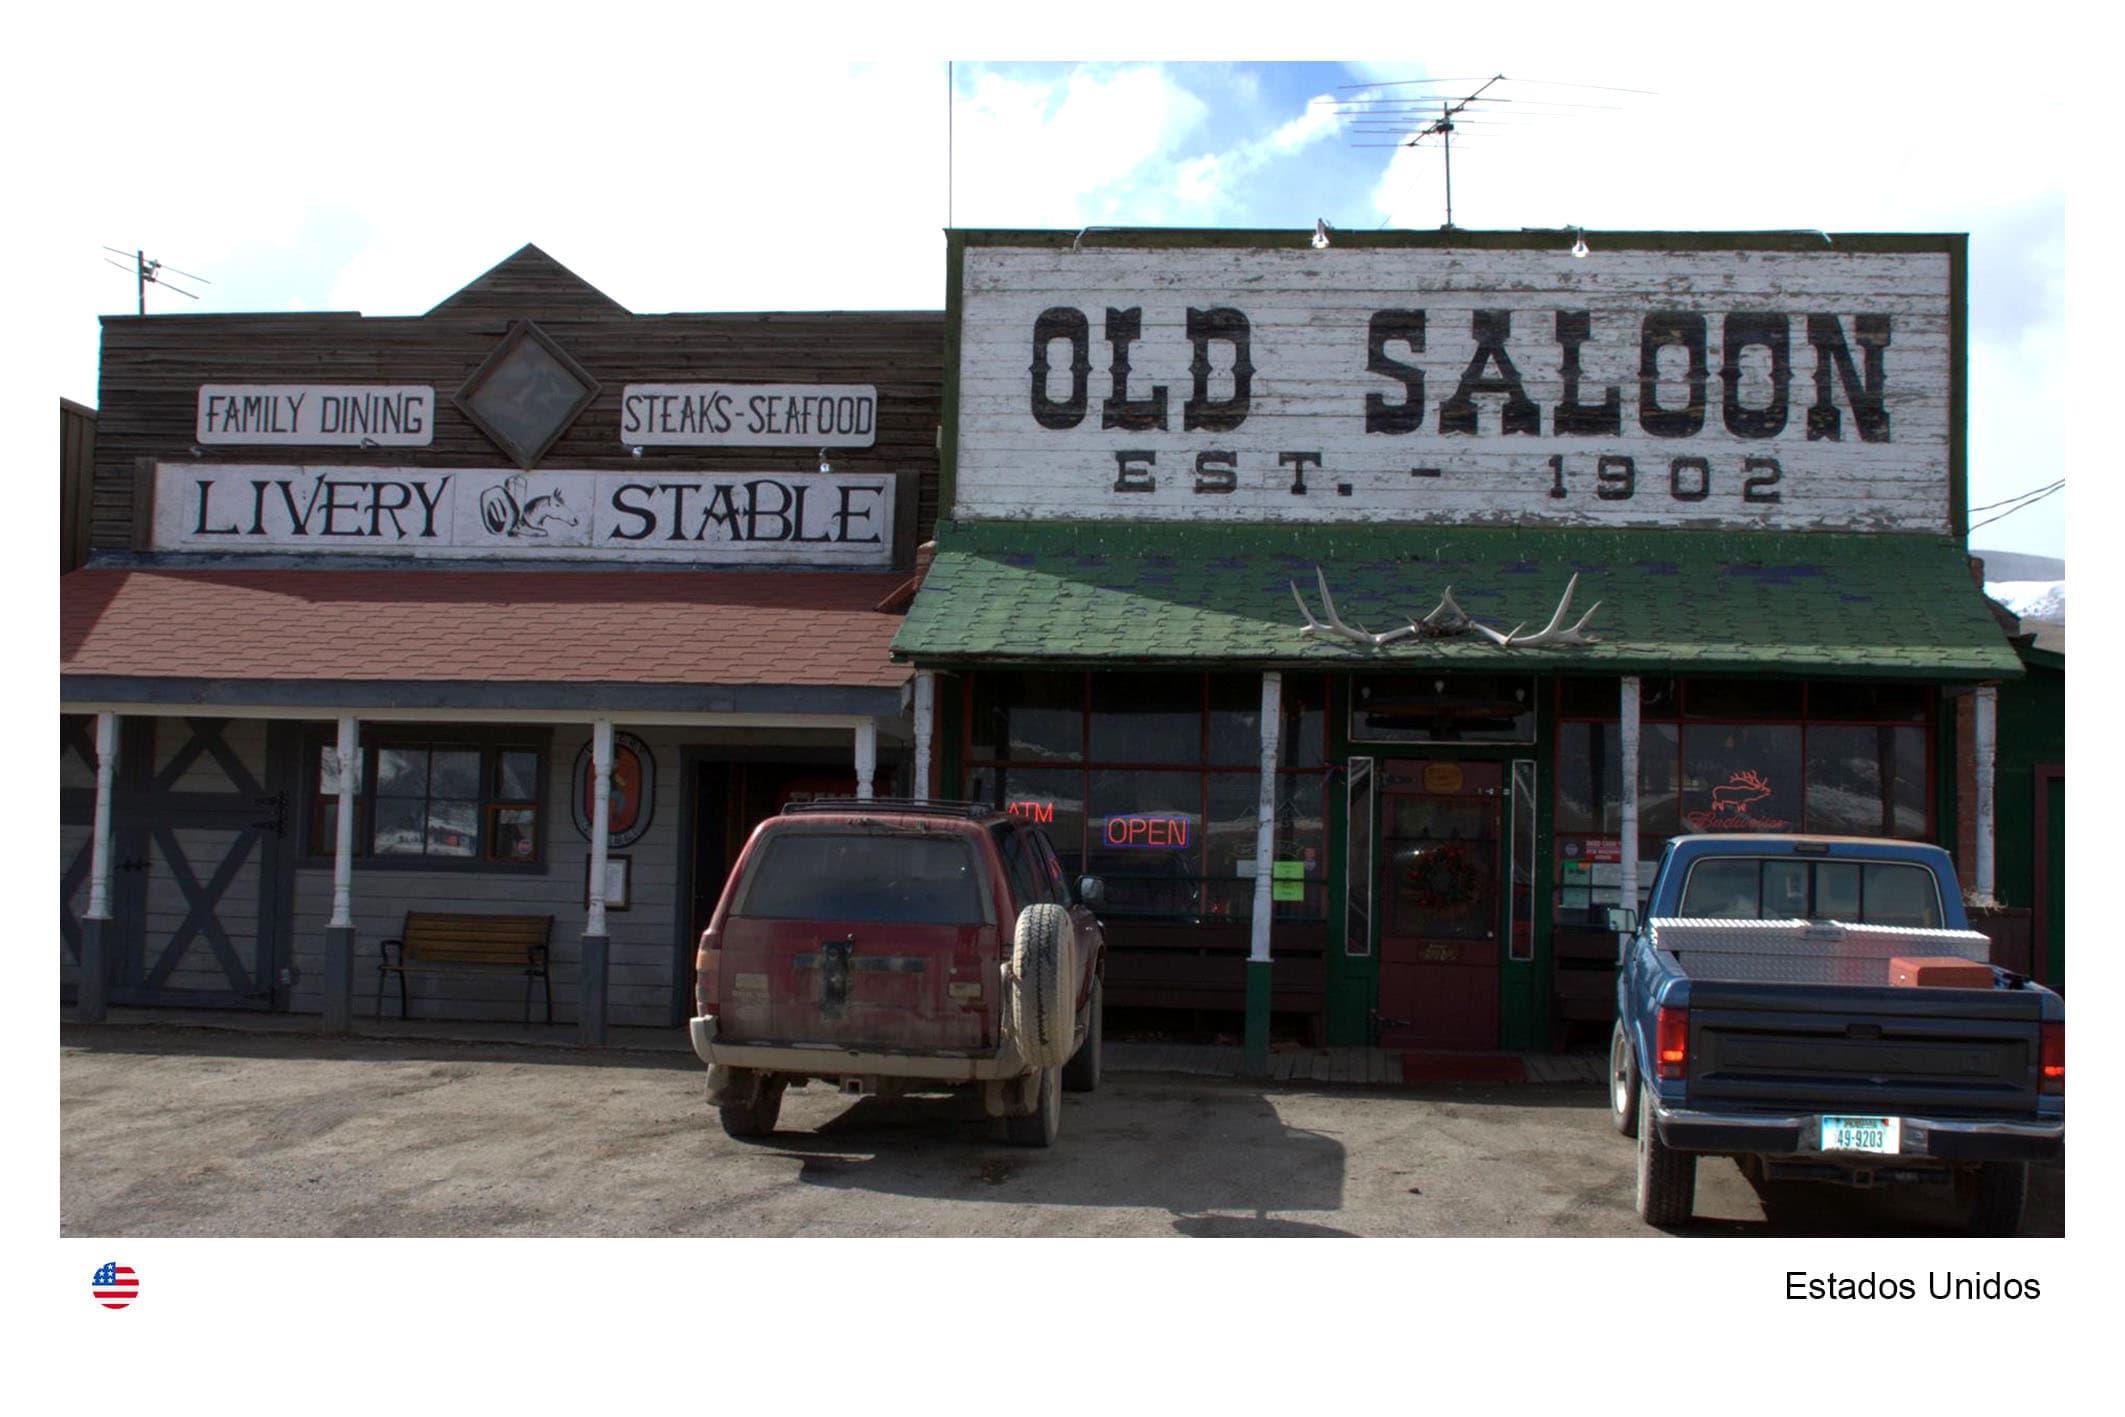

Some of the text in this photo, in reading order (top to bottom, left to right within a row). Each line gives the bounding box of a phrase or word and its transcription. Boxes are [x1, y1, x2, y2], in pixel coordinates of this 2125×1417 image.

[1028, 306, 1893, 443] OLD SALOON
[206, 391, 424, 434] FAMILY DINING
[1113, 450, 1353, 496] EST.
[1548, 454, 1782, 502] 1902
[193, 473, 884, 544] LIVERY STABLE
[1008, 801, 1053, 824] ATM
[1107, 817, 1188, 846] OPEN
[1837, 1129, 1883, 1148] 49-9203
